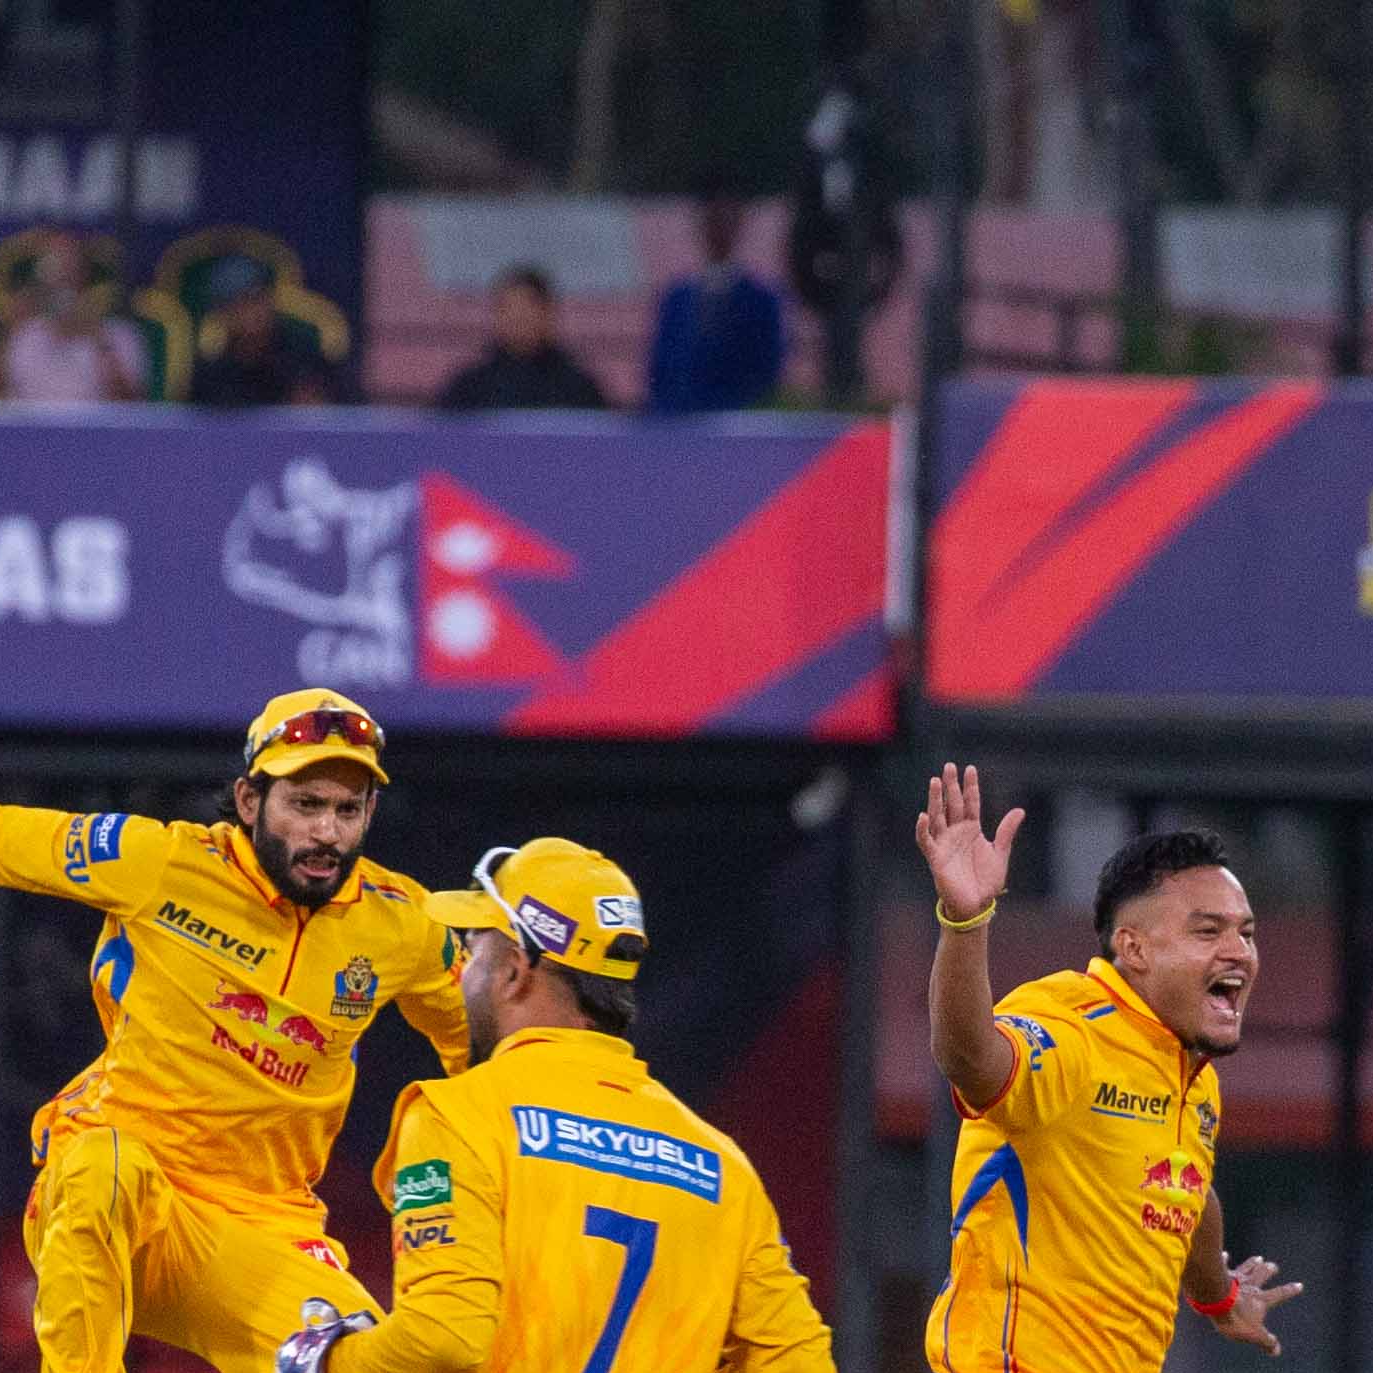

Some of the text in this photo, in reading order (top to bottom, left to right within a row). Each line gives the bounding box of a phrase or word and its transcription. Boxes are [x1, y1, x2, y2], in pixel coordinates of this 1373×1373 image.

[158, 900, 269, 967] Marvel
[578, 938, 592, 956] 7
[210, 1023, 311, 1088] Red Bull
[555, 1117, 719, 1179] SKYWELL
[403, 1224, 457, 1249] NPL
